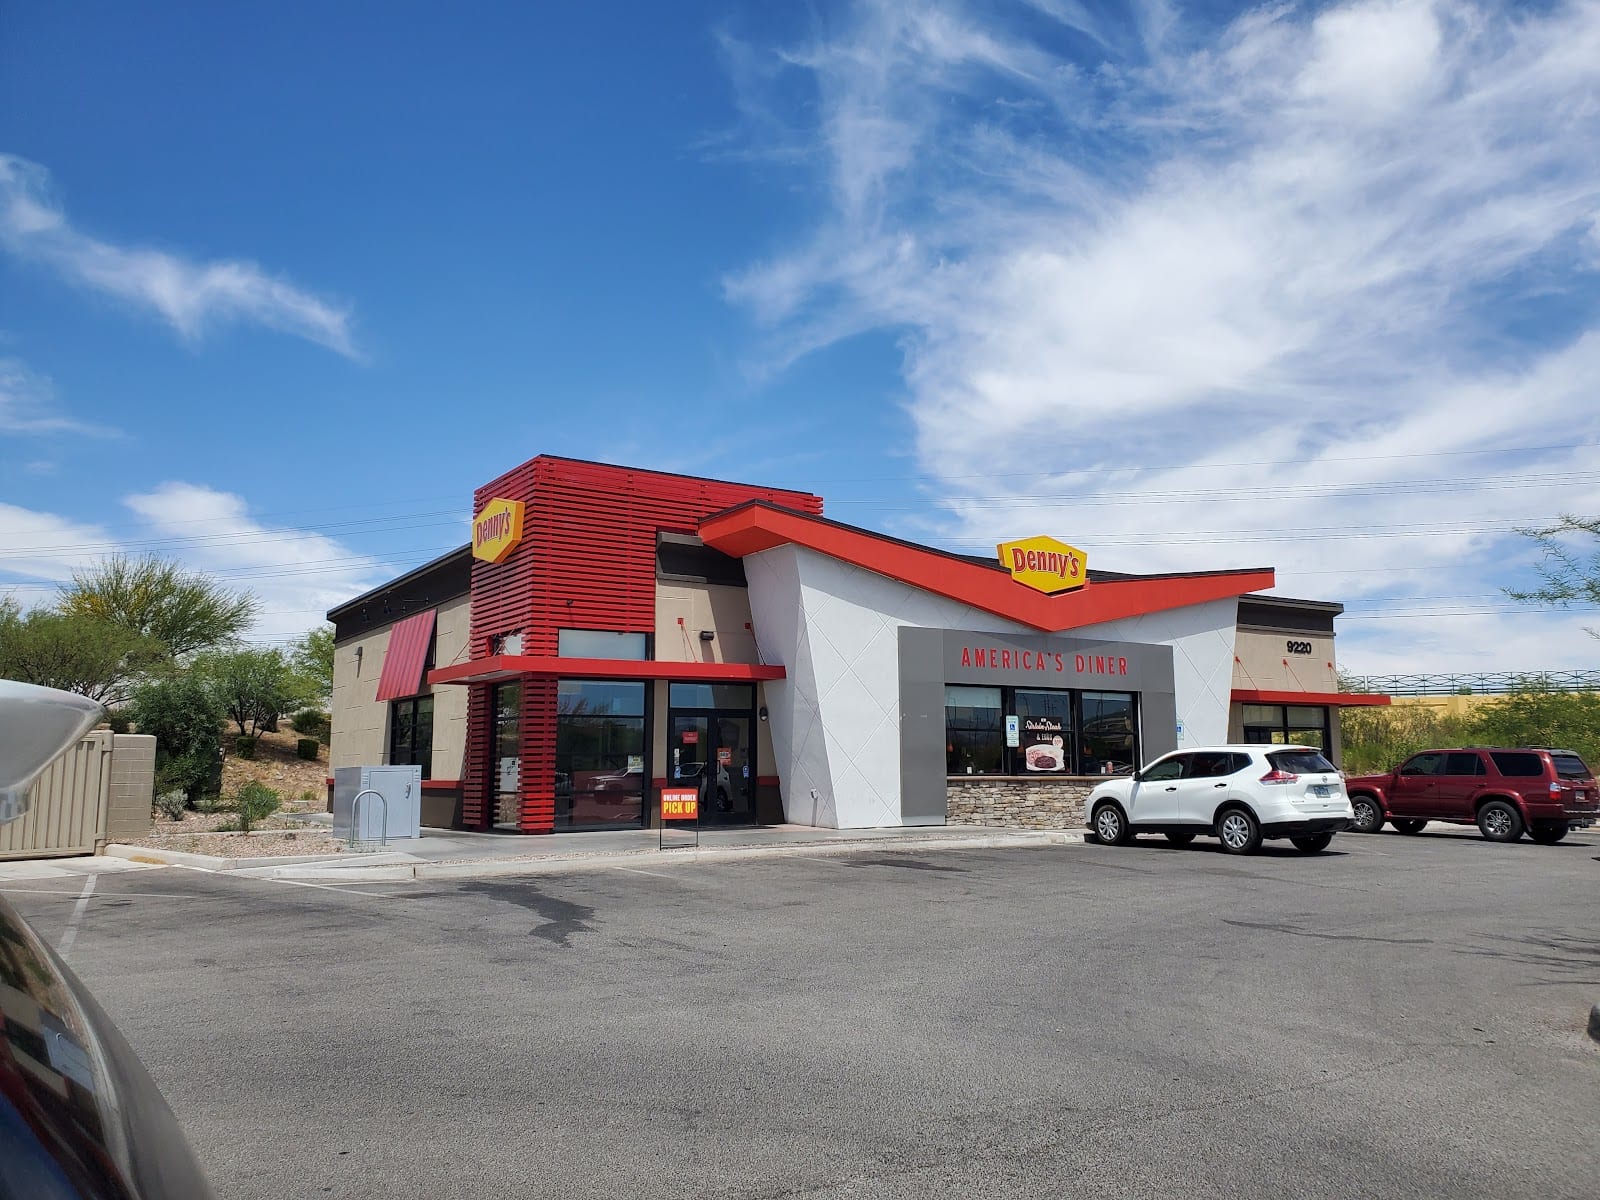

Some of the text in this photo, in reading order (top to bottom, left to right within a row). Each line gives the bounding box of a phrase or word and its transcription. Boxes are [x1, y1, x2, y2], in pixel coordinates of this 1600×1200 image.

[477, 506, 511, 548] Denny's
[1011, 547, 1079, 578] Denny's
[961, 647, 1128, 675] AMERICA'S DINER
[1287, 641, 1311, 654] 9220
[663, 802, 696, 814] PICK UP
